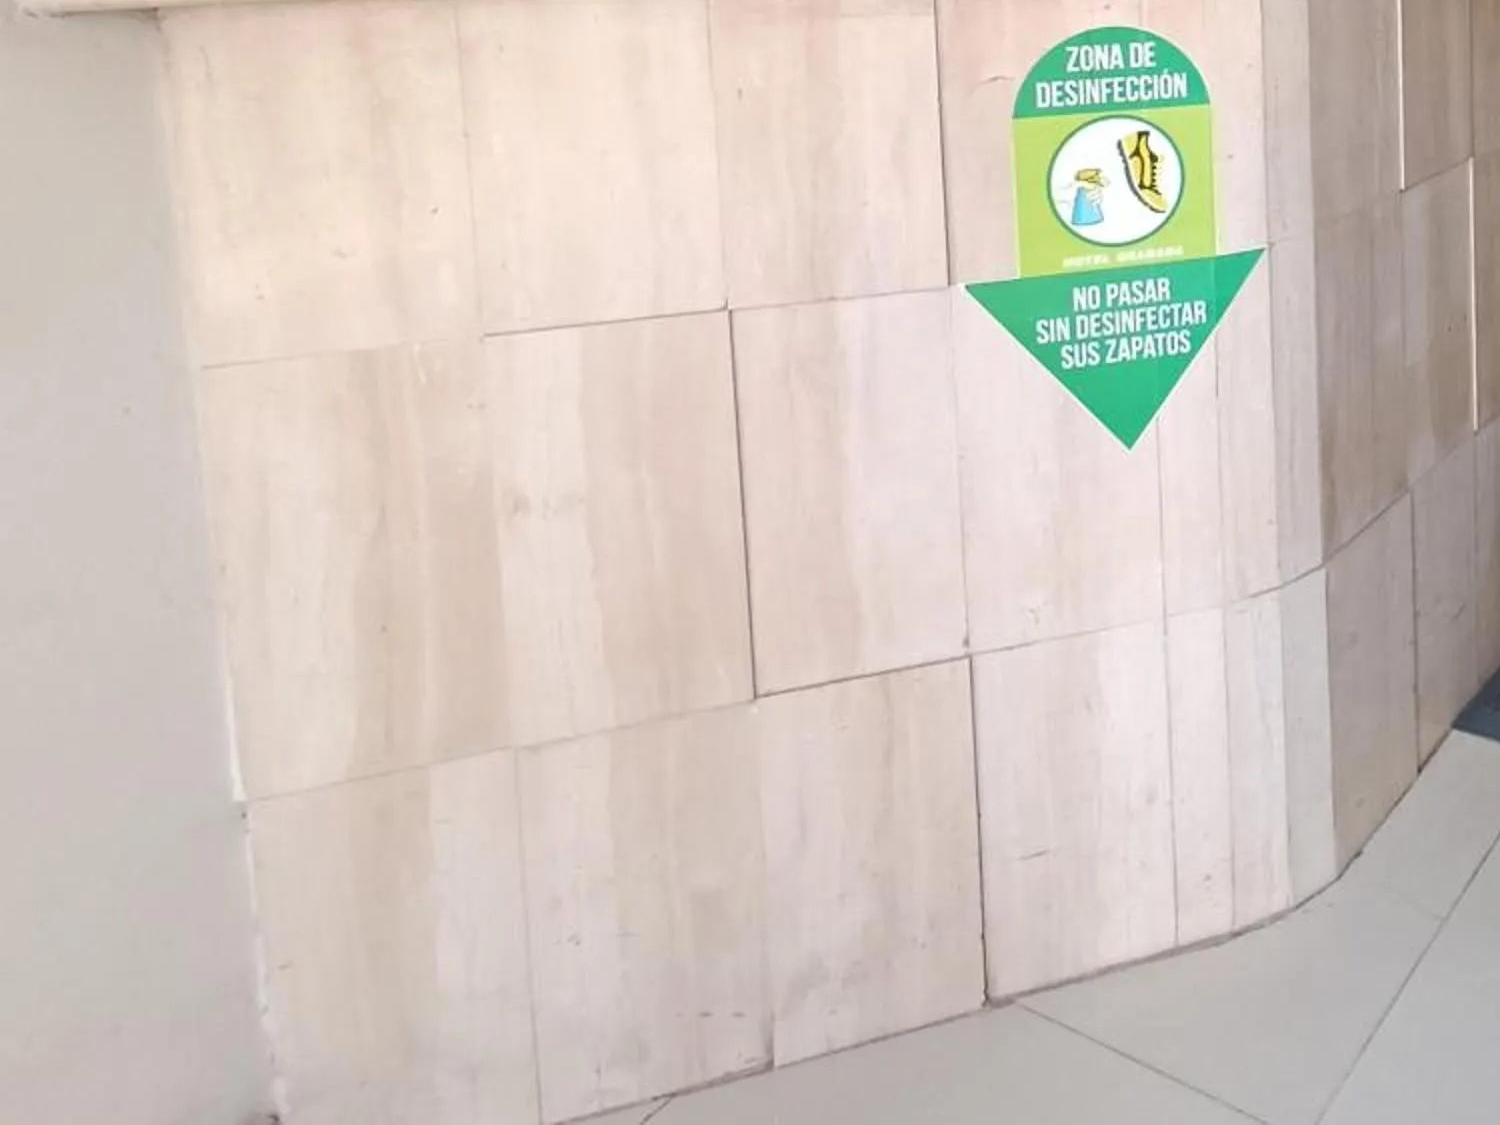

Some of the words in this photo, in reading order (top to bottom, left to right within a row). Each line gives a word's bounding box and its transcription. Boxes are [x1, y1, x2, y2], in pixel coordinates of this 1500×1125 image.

[1066, 43, 1124, 73] ZONA
[1129, 41, 1157, 69] DE
[1035, 68, 1188, 109] DESINFECCIÓN
[1072, 284, 1101, 311] NO
[1106, 278, 1171, 309] PASAR
[1035, 319, 1070, 345] SIN
[1075, 300, 1207, 340] DESINFECTAR
[1060, 343, 1100, 370] SUS
[1105, 330, 1191, 364] ZAPATOS
